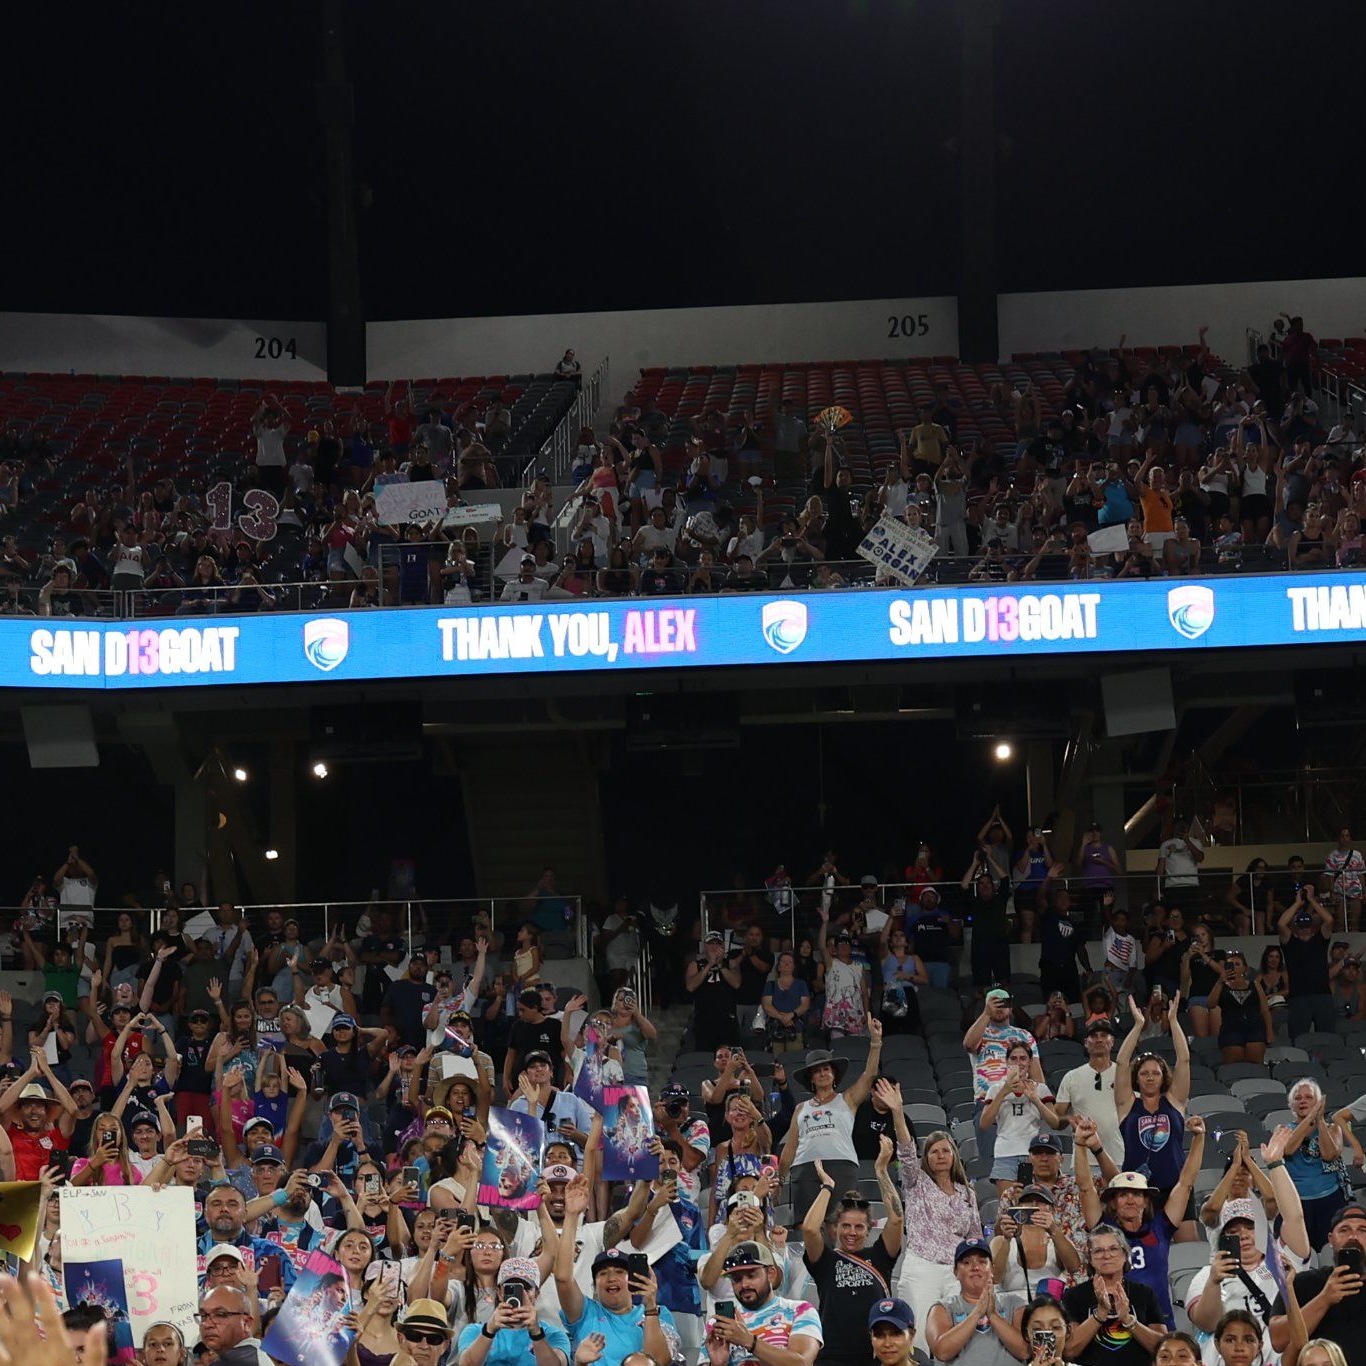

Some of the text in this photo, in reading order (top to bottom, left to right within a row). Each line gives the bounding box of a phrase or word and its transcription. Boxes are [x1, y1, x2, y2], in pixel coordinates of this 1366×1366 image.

[887, 314, 930, 339] 205
[254, 337, 297, 361] 204
[206, 481, 280, 542] 13
[408, 507, 440, 519] GOAT
[860, 538, 920, 580] MORGAN
[878, 537, 919, 566] ALEX
[890, 594, 1100, 645] SAN D13GOAT
[438, 609, 697, 662] THANK YOU, ALEX
[31, 627, 239, 675] SAN D13GOAT
[1011, 1102, 1024, 1116] 13
[1129, 1246, 1146, 1270] 3
[836, 1279, 874, 1288] SPORTS.
[169, 1302, 196, 1315] FROM
